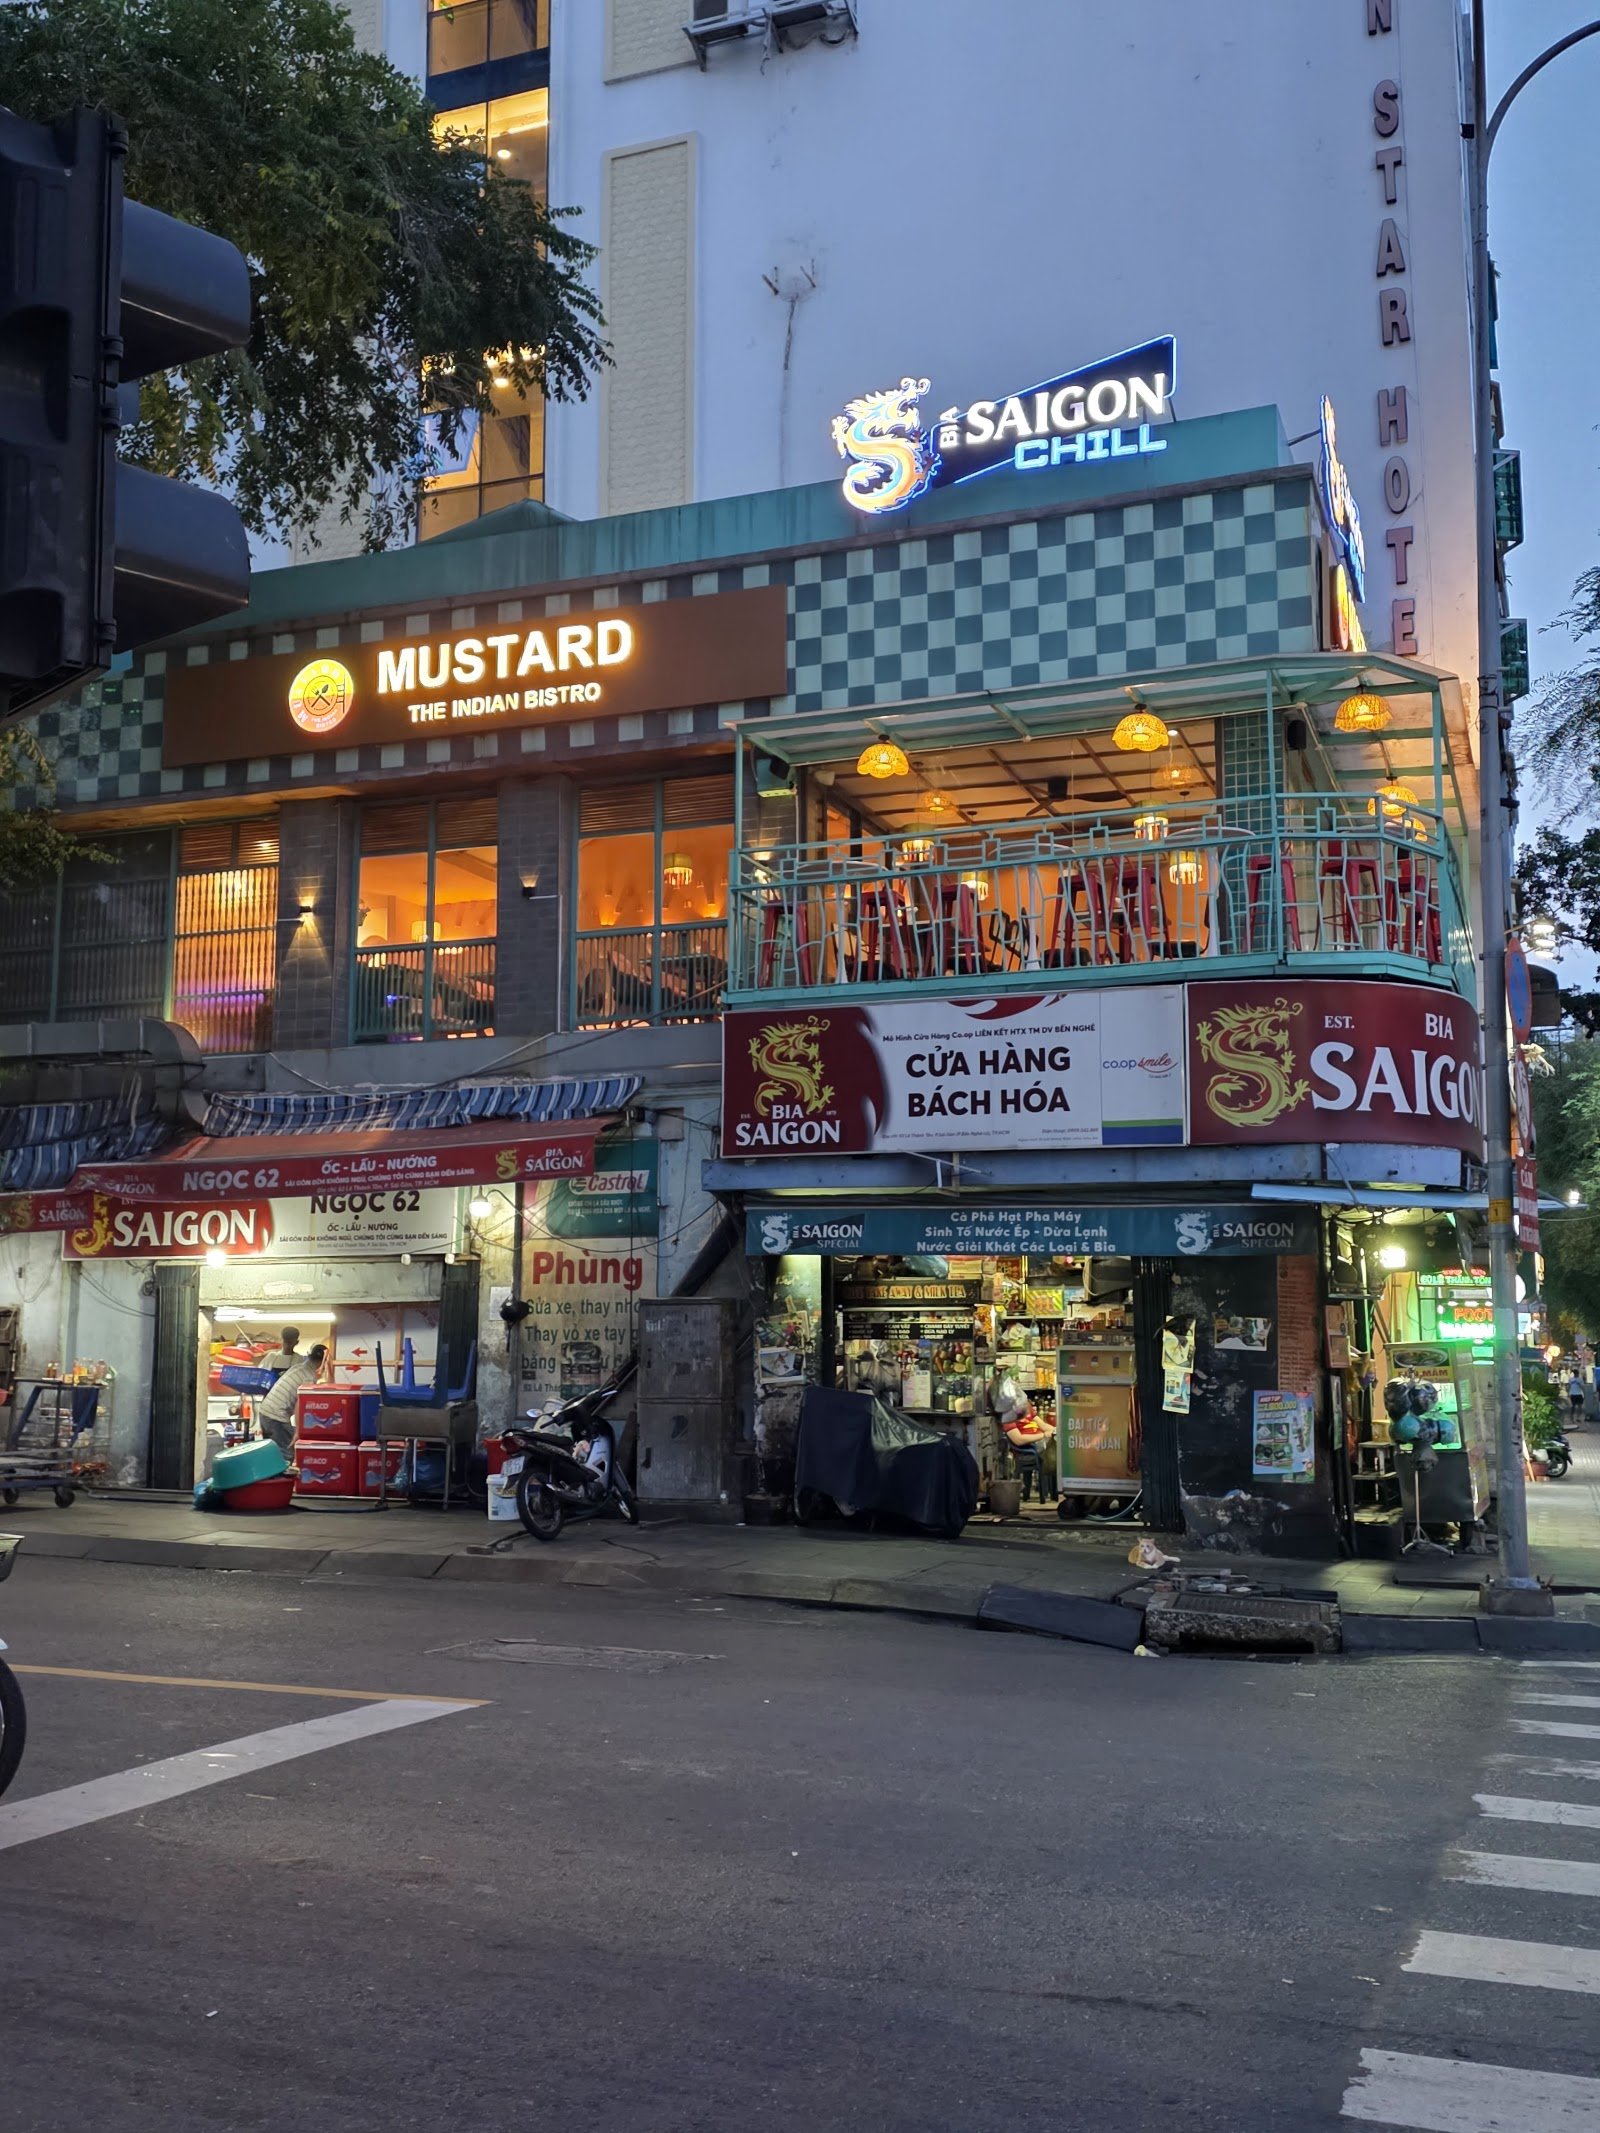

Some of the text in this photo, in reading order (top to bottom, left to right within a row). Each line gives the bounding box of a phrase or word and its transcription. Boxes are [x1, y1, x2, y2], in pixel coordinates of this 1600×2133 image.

[1373, 79, 1418, 655] STAR HOTE
[940, 372, 1167, 447] BIA SAIGON
[1014, 423, 1167, 471] CHILL
[377, 619, 632, 694] MUSTARD
[408, 682, 602, 723] THE INDIAN BISTRO
[1010, 1027, 1027, 1035] HTX
[1324, 1013, 1454, 1041] EST. BIA
[905, 1042, 1071, 1078] CỬA HÀNG
[907, 1080, 1071, 1118] BÁCH HÓA
[772, 1104, 804, 1119] BIA
[735, 1120, 840, 1146] SAIGON
[525, 1155, 584, 1172] SAIGON
[546, 1148, 563, 1157] BIA
[182, 1168, 280, 1196] NGỌC 62
[588, 1172, 644, 1192] Castrol
[38, 1208, 86, 1223] SAIGON
[310, 1190, 421, 1220] NGỌC 62
[113, 1209, 257, 1247] SAIGON
[951, 1210, 1082, 1225] Cà Phê Hạt Pha Máy
[801, 1224, 863, 1238] SAIGON
[925, 1226, 953, 1237] Sinh
[956, 1225, 973, 1237] Tố
[975, 1226, 1011, 1237] Nước
[1014, 1223, 1030, 1239] Ép
[1043, 1225, 1071, 1237] Dừa
[1074, 1225, 1108, 1240] Lạnh
[1222, 1222, 1294, 1238] SAIGON
[916, 1241, 1116, 1255] Nước Giải Khát Các Loại & Bia
[532, 1249, 643, 1291] Phùng
[580, 1300, 610, 1318] thay
[525, 1326, 558, 1345] Thay
[563, 1323, 580, 1340] vỏ
[584, 1328, 600, 1340] xe
[604, 1327, 626, 1344] tay
[521, 1352, 556, 1374] bằng
